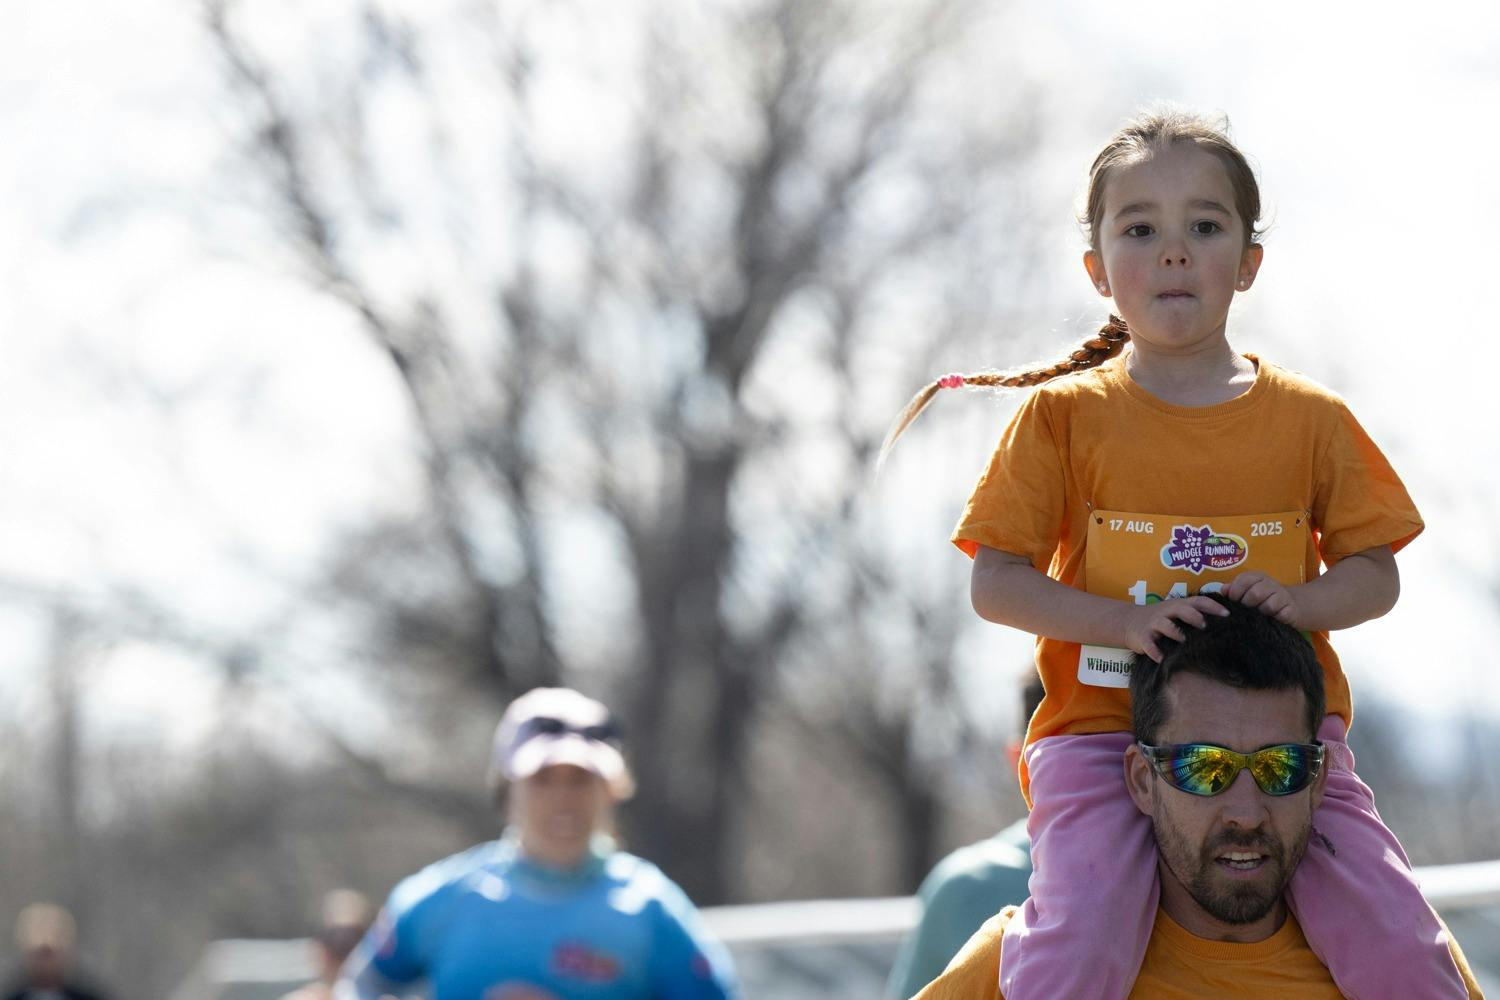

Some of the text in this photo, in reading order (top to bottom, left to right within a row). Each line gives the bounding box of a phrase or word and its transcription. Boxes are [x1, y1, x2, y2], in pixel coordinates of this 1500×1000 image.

[1109, 519, 1154, 533] 17 AUG
[1251, 521, 1283, 536] 2025
[1171, 544, 1235, 561] MUDGEE RUNNING
[1087, 657, 1135, 675] Wilpinjo
